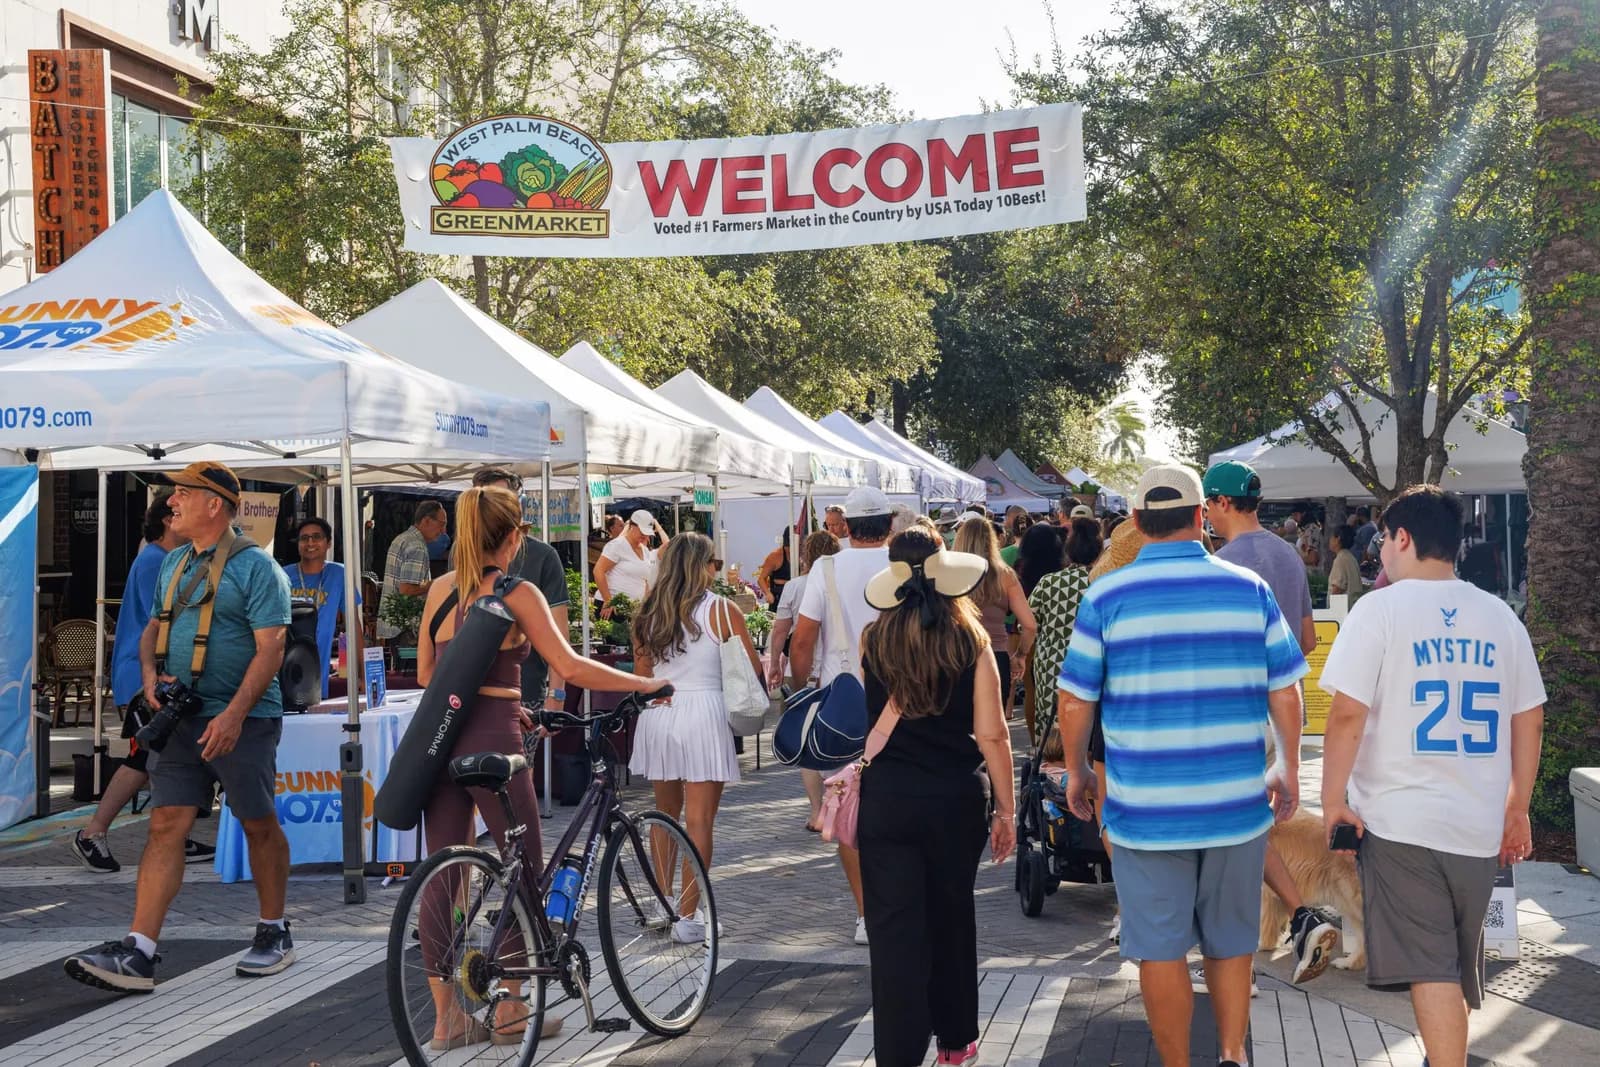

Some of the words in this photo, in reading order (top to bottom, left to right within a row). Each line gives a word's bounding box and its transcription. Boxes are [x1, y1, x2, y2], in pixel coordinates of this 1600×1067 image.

[34, 56, 64, 267] BATCH
[70, 108, 84, 211] SOUTHERN
[86, 108, 100, 200] KITCHEN
[442, 129, 488, 163] WEST
[491, 121, 543, 136] PALM
[546, 124, 603, 165] BEACH
[637, 126, 1044, 218] WELCOME
[654, 221, 692, 235] Voted
[694, 218, 709, 234] #1
[712, 217, 764, 233] Farmers
[766, 213, 811, 230] Market
[813, 212, 827, 226] in
[829, 211, 850, 225] the
[853, 206, 904, 226] Country
[906, 204, 923, 221] by
[925, 200, 952, 216] USA
[954, 196, 993, 217] Today
[996, 193, 1047, 209] 10Best!
[0, 298, 162, 327] UNNY
[63, 327, 94, 335] FM
[244, 501, 279, 518] Brothers
[1413, 637, 1496, 668] MYSTIC
[427, 709, 455, 756] LIFORME
[1411, 679, 1500, 758] 25
[274, 770, 342, 795] SUNN
[573, 832, 601, 921] cannondale
